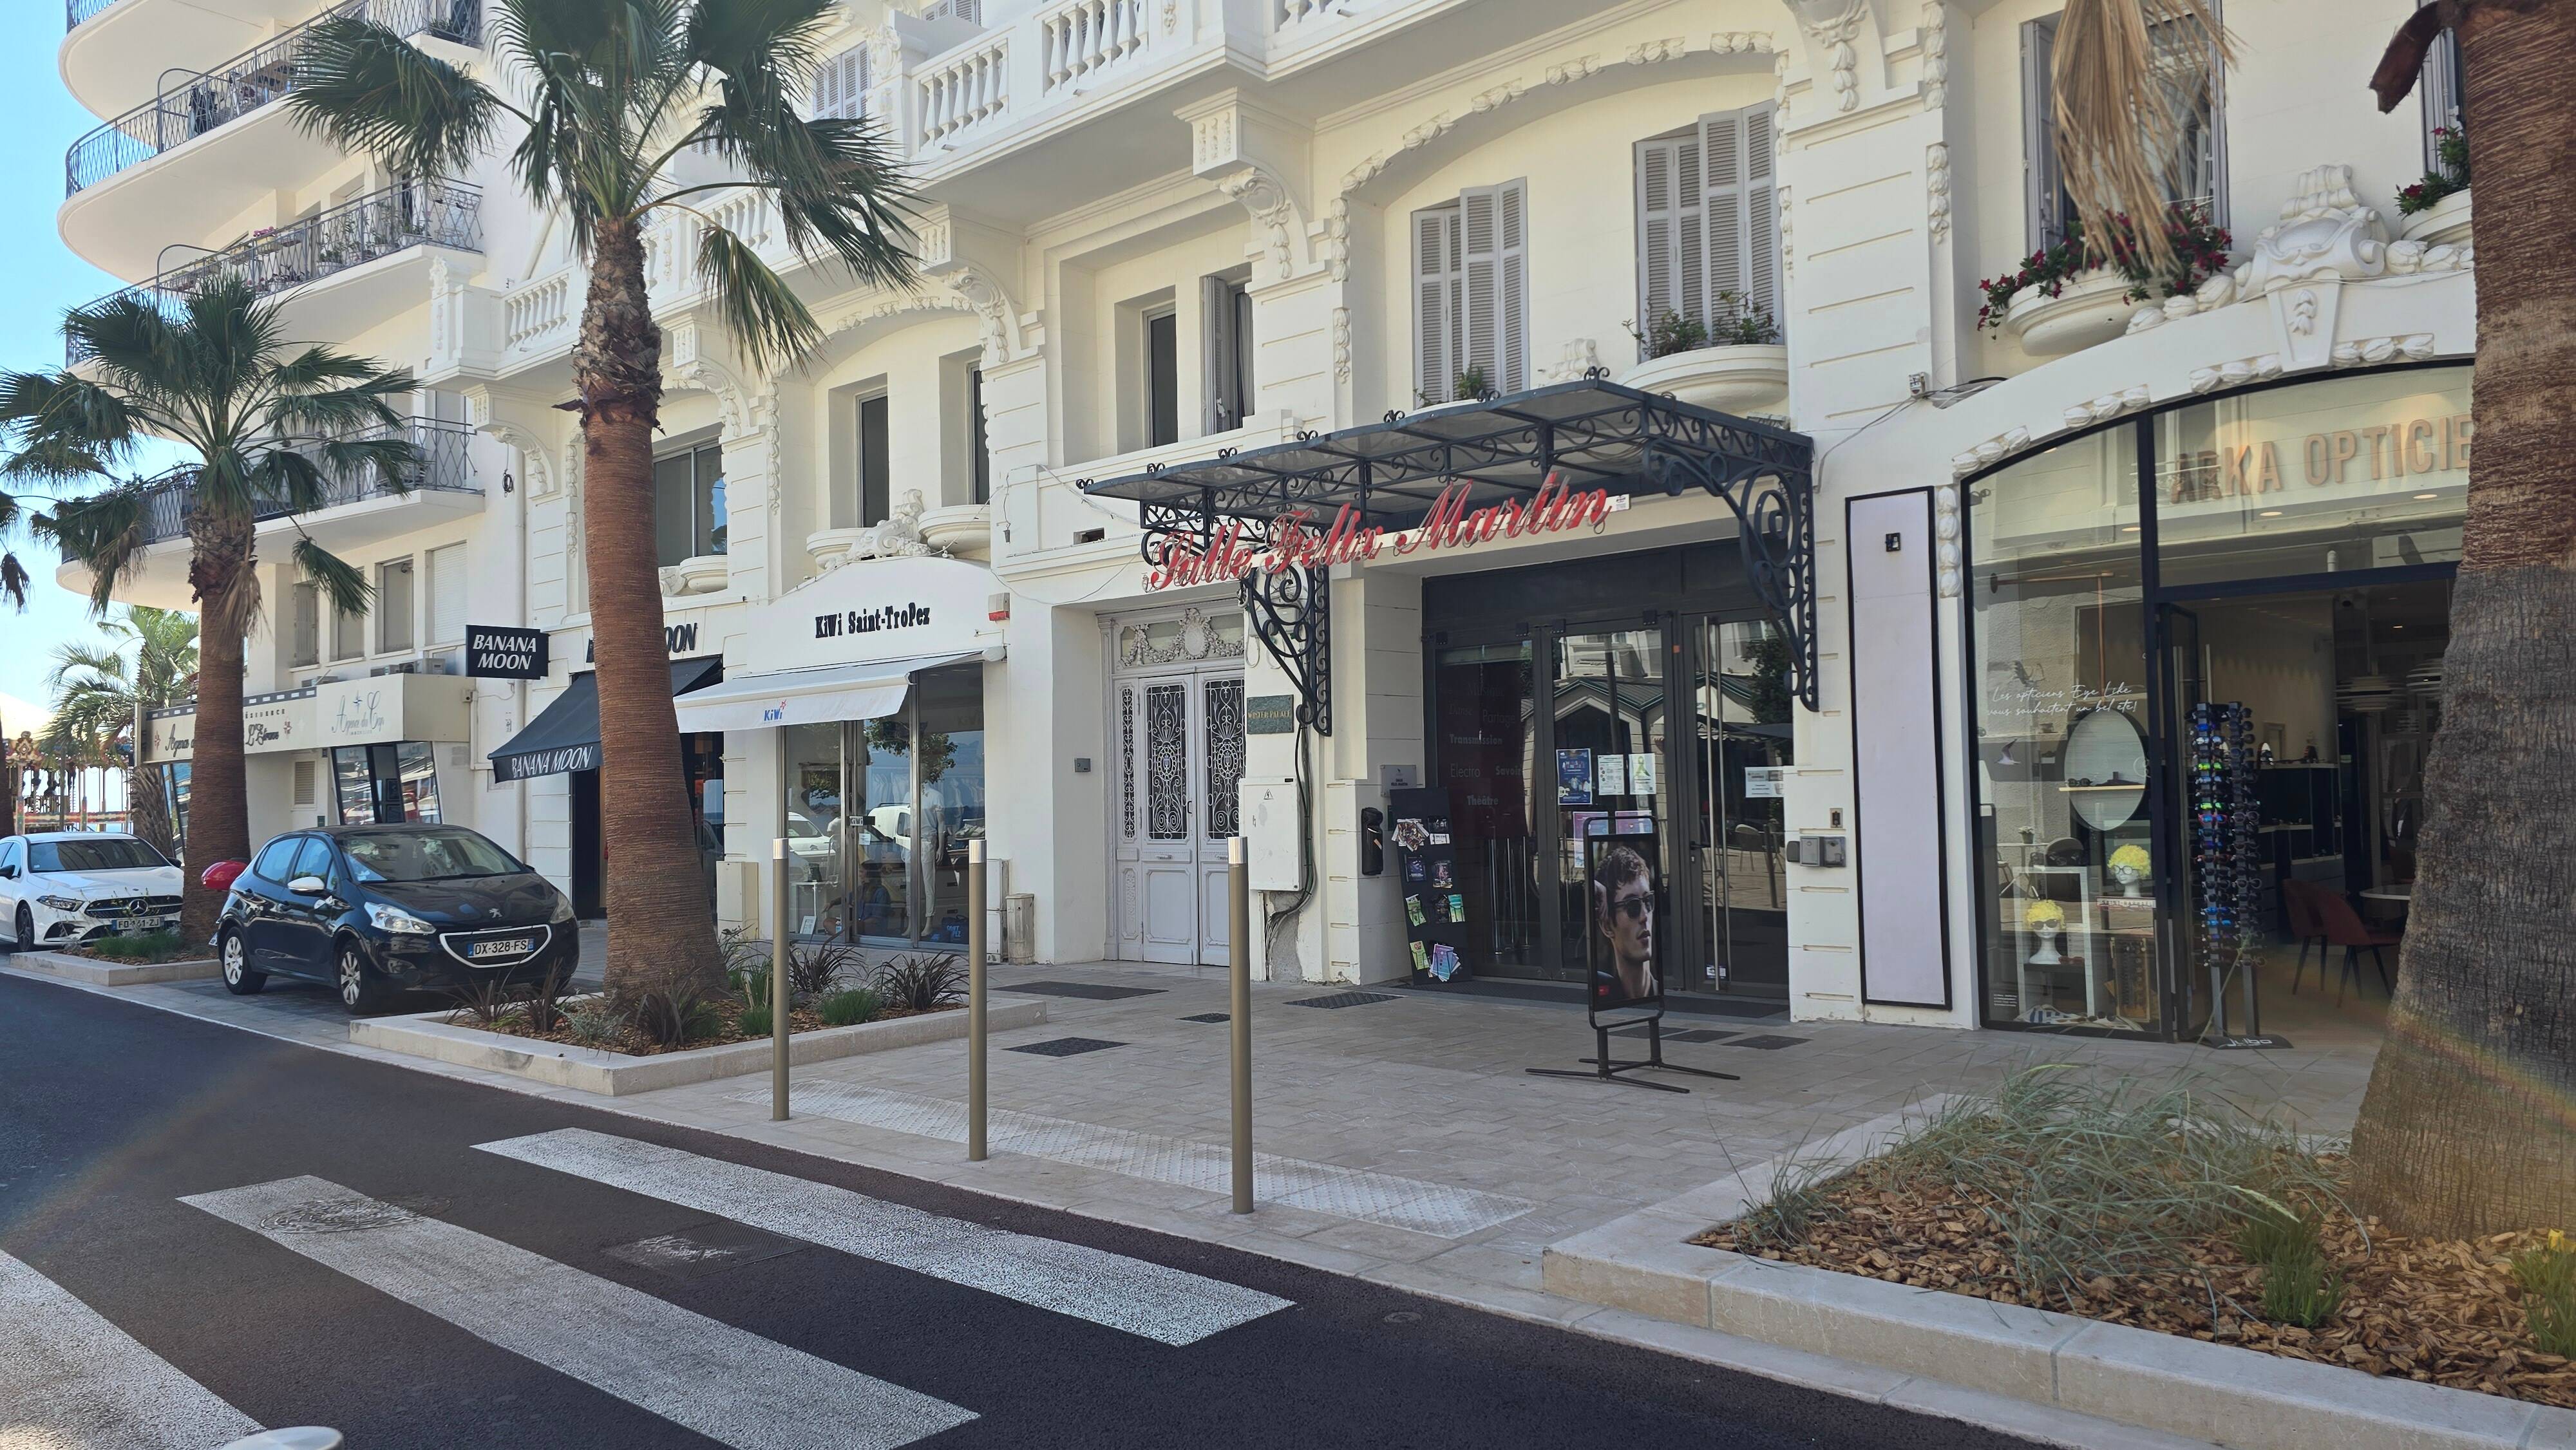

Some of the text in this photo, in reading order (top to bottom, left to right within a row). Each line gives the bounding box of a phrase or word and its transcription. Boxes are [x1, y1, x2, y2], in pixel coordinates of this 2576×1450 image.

[2171, 413, 2472, 504] ARKA OPTICIE
[1393, 471, 1612, 557] Martin
[473, 634, 536, 652] BANANA
[664, 622, 697, 653] OON
[477, 653, 532, 670] MOON
[1992, 681, 2133, 702] Les opticiens Eye Like
[2016, 701, 2076, 716] souhaitent
[2095, 699, 2114, 713] bel
[1450, 733, 1502, 745] Transmission
[512, 746, 593, 778] BANANA MOON
[1450, 764, 1481, 778] Electro
[475, 940, 527, 955] DX-328-FS
